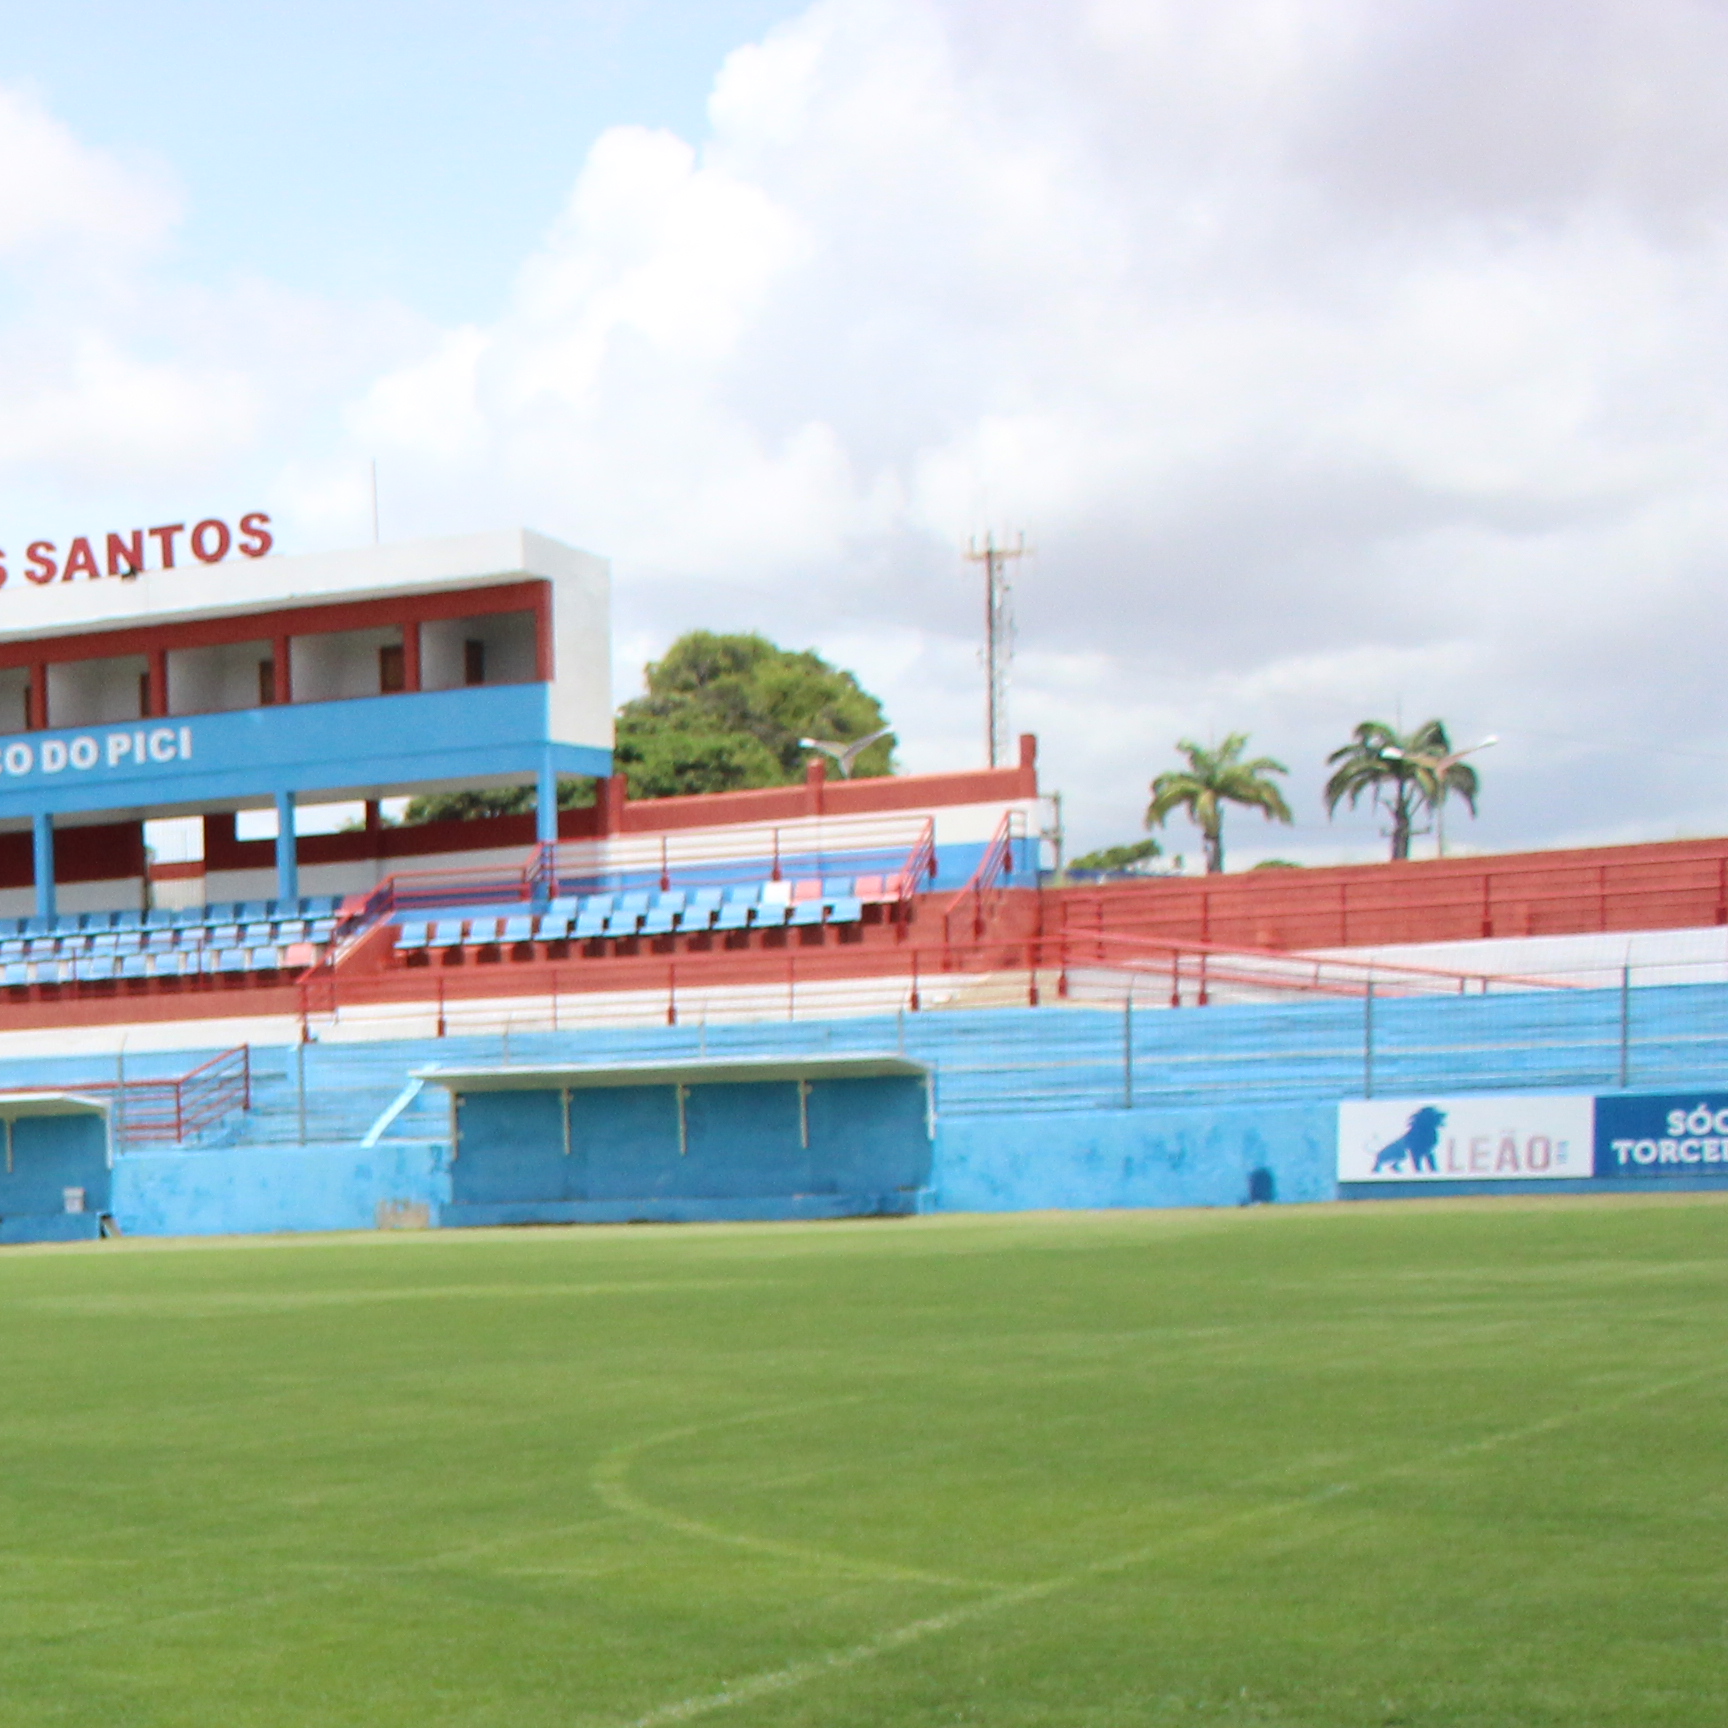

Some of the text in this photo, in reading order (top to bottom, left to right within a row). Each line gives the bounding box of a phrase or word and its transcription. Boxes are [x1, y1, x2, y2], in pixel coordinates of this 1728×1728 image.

[24, 511, 274, 585] SANTOS
[41, 736, 100, 774] DO
[106, 726, 193, 769] PICI
[1446, 1127, 1552, 1173] LEÃO
